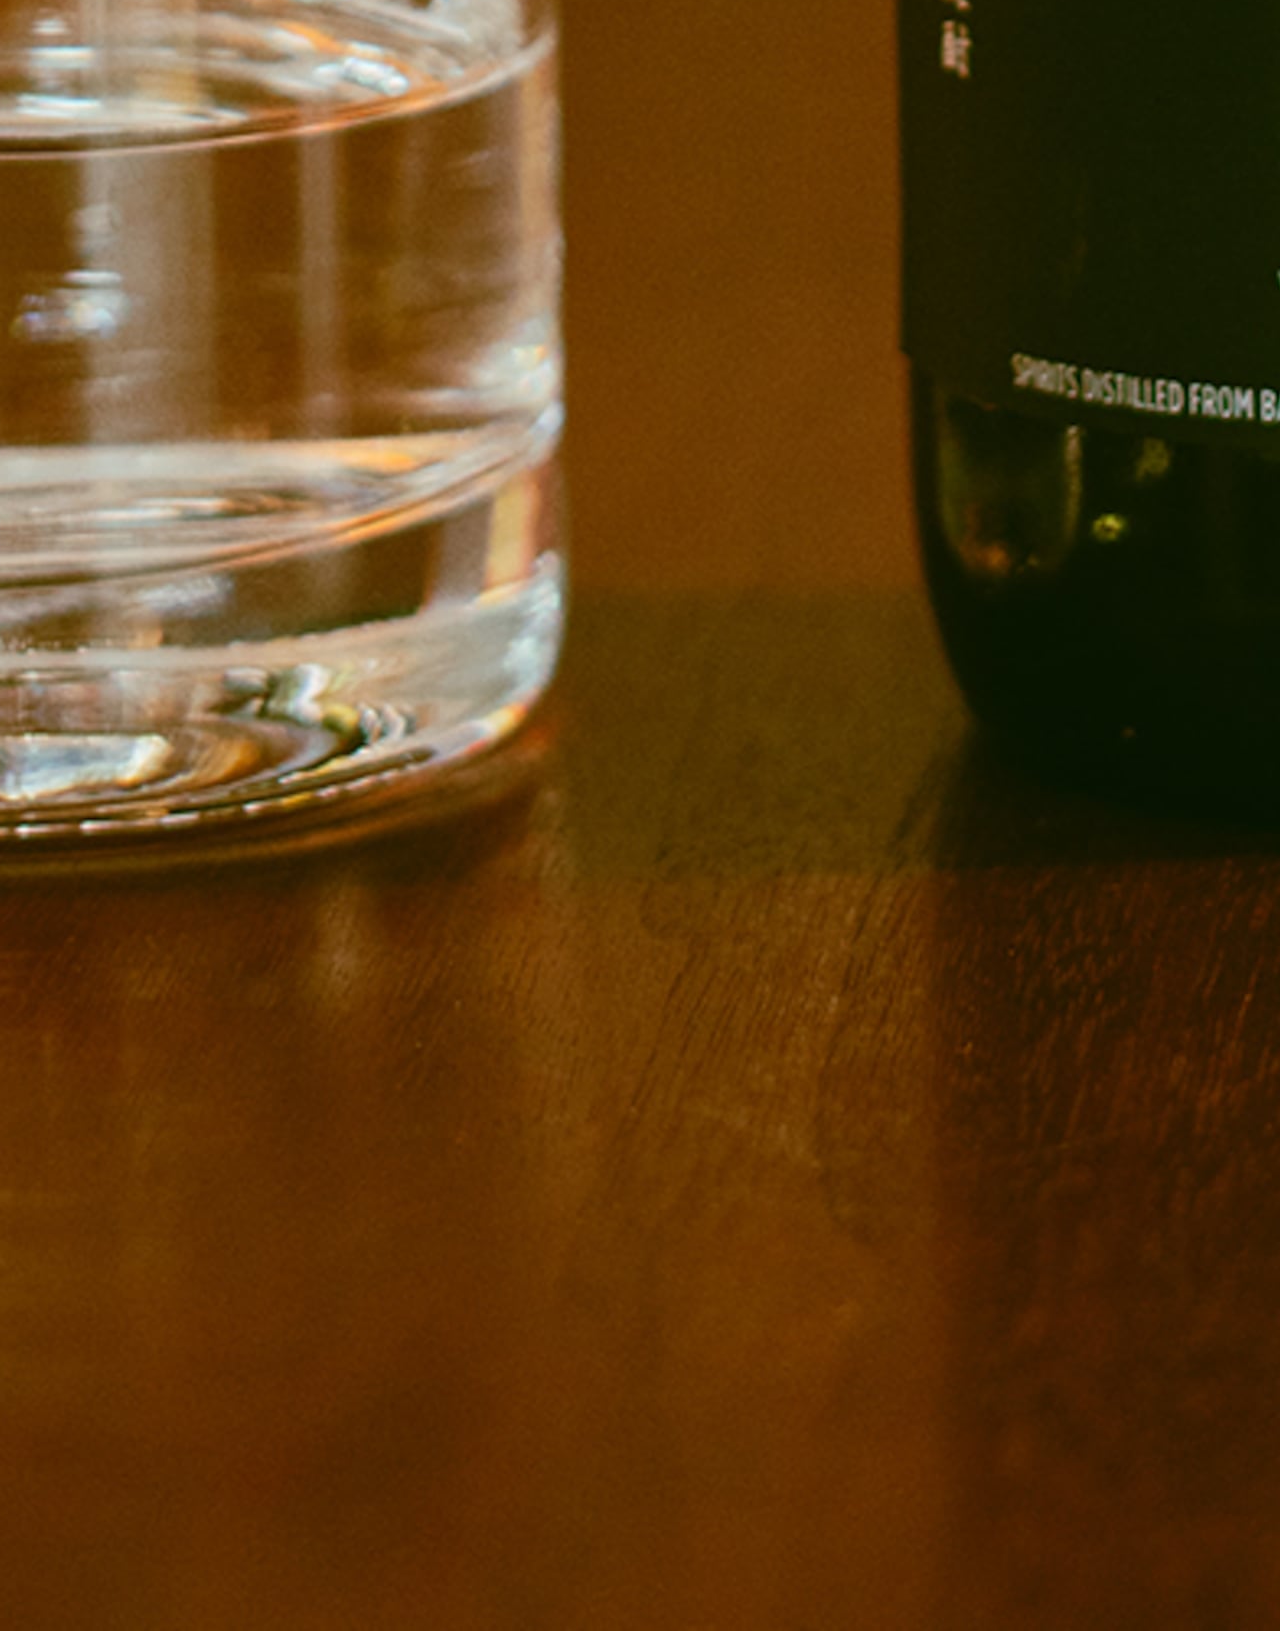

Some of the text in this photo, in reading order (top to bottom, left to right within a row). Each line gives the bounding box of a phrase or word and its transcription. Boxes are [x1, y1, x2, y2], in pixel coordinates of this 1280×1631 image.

[1011, 351, 1078, 400] SPIRITS
[1081, 367, 1184, 416] DISTILLED
[1188, 381, 1256, 421] FROM
